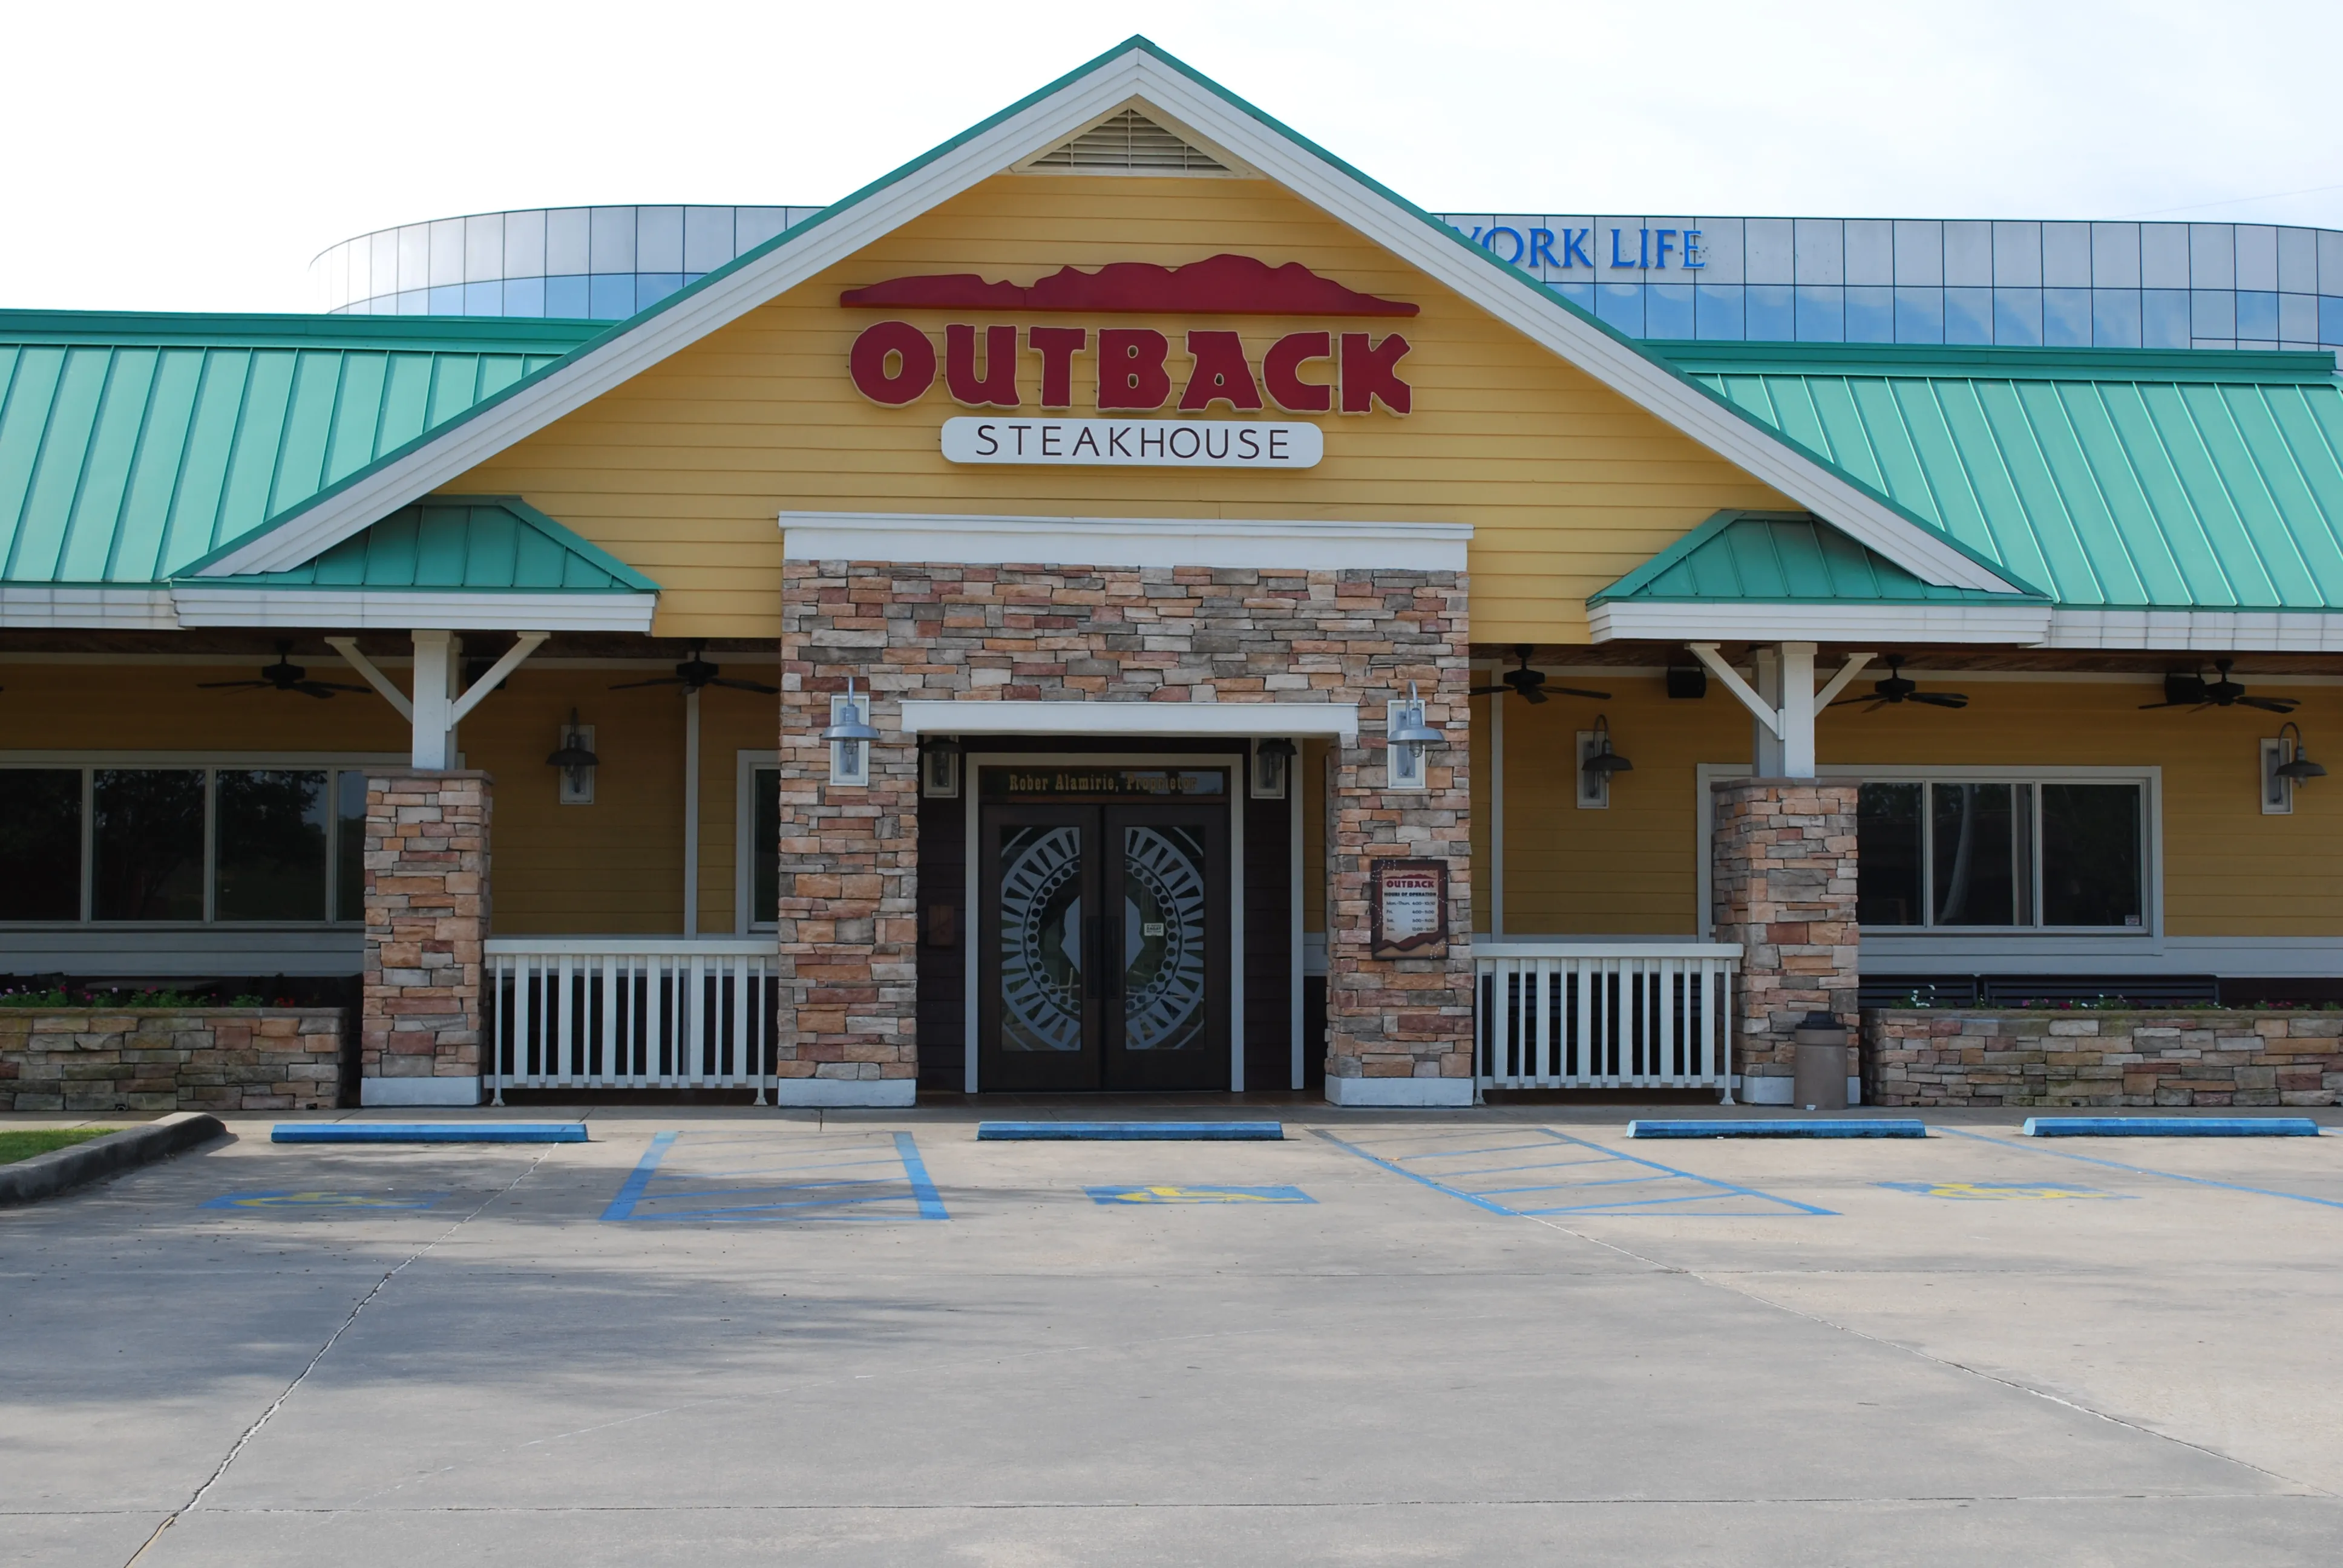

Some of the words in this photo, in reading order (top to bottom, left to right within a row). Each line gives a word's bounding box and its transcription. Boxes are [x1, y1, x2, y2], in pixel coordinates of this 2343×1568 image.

[1610, 228, 1706, 269] LIFE
[849, 319, 1412, 417] OUTBACK
[975, 423, 1290, 460] STEAKHOUSE
[1009, 774, 1049, 791] Rober
